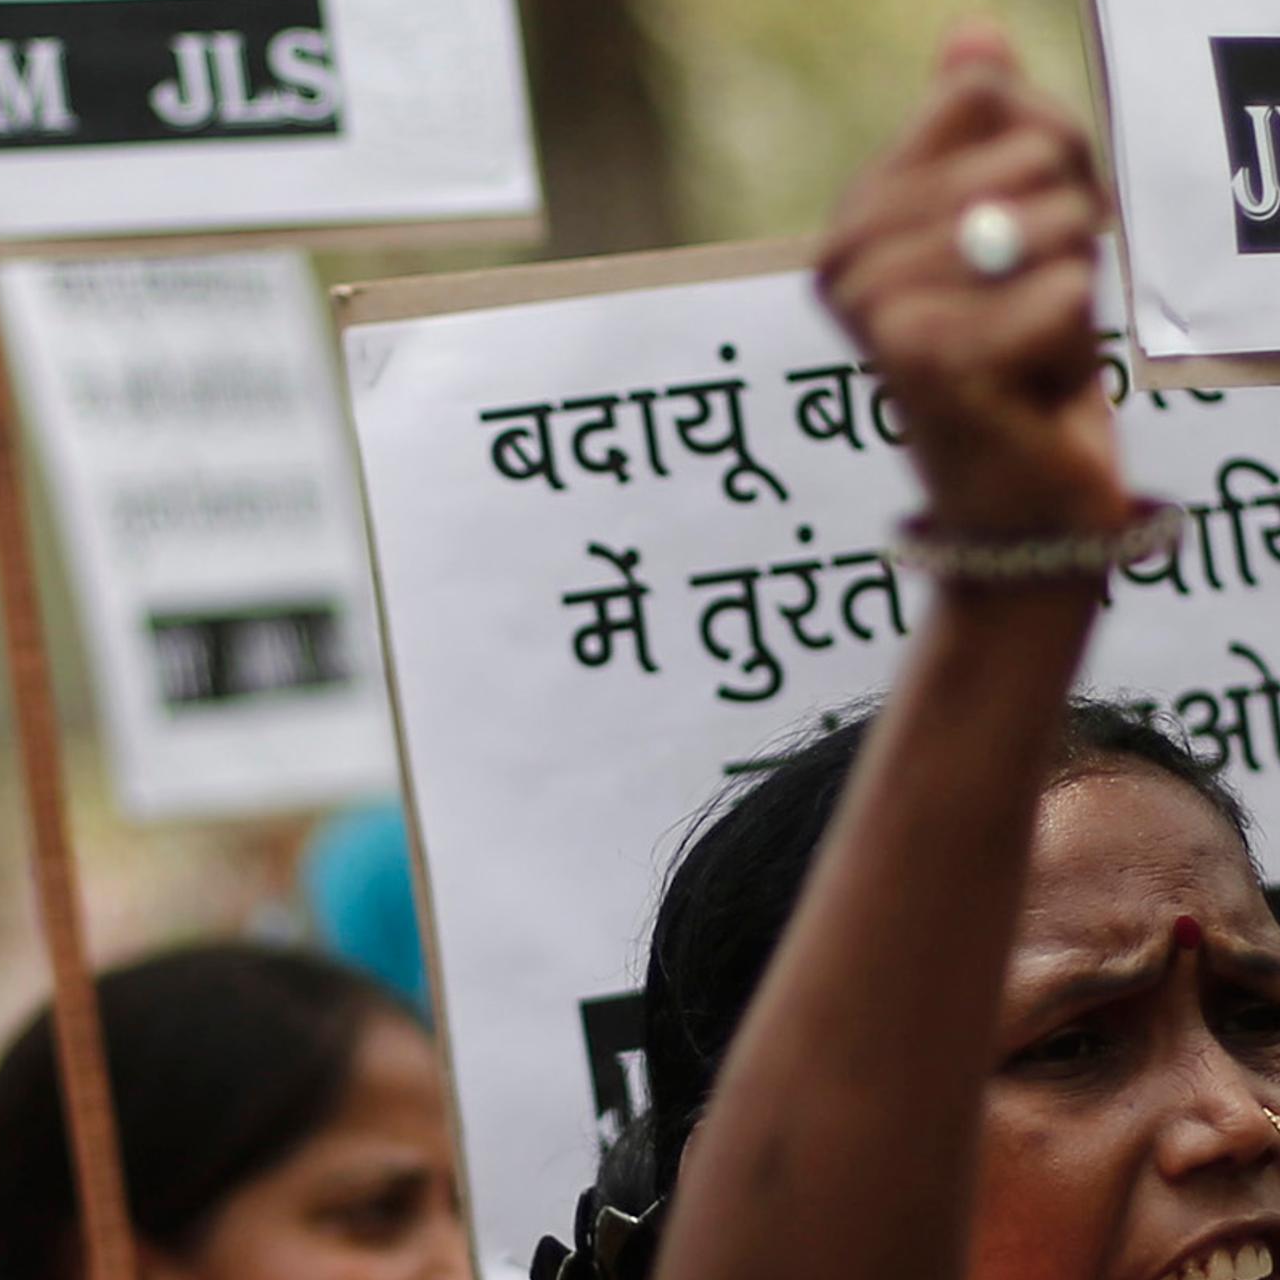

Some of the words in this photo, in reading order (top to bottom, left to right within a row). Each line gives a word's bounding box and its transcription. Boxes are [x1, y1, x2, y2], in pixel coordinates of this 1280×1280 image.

[152, 27, 339, 130] JLS
[479, 344, 791, 504] बदायूं
[562, 542, 660, 674] में
[689, 525, 910, 703] तुरंत
